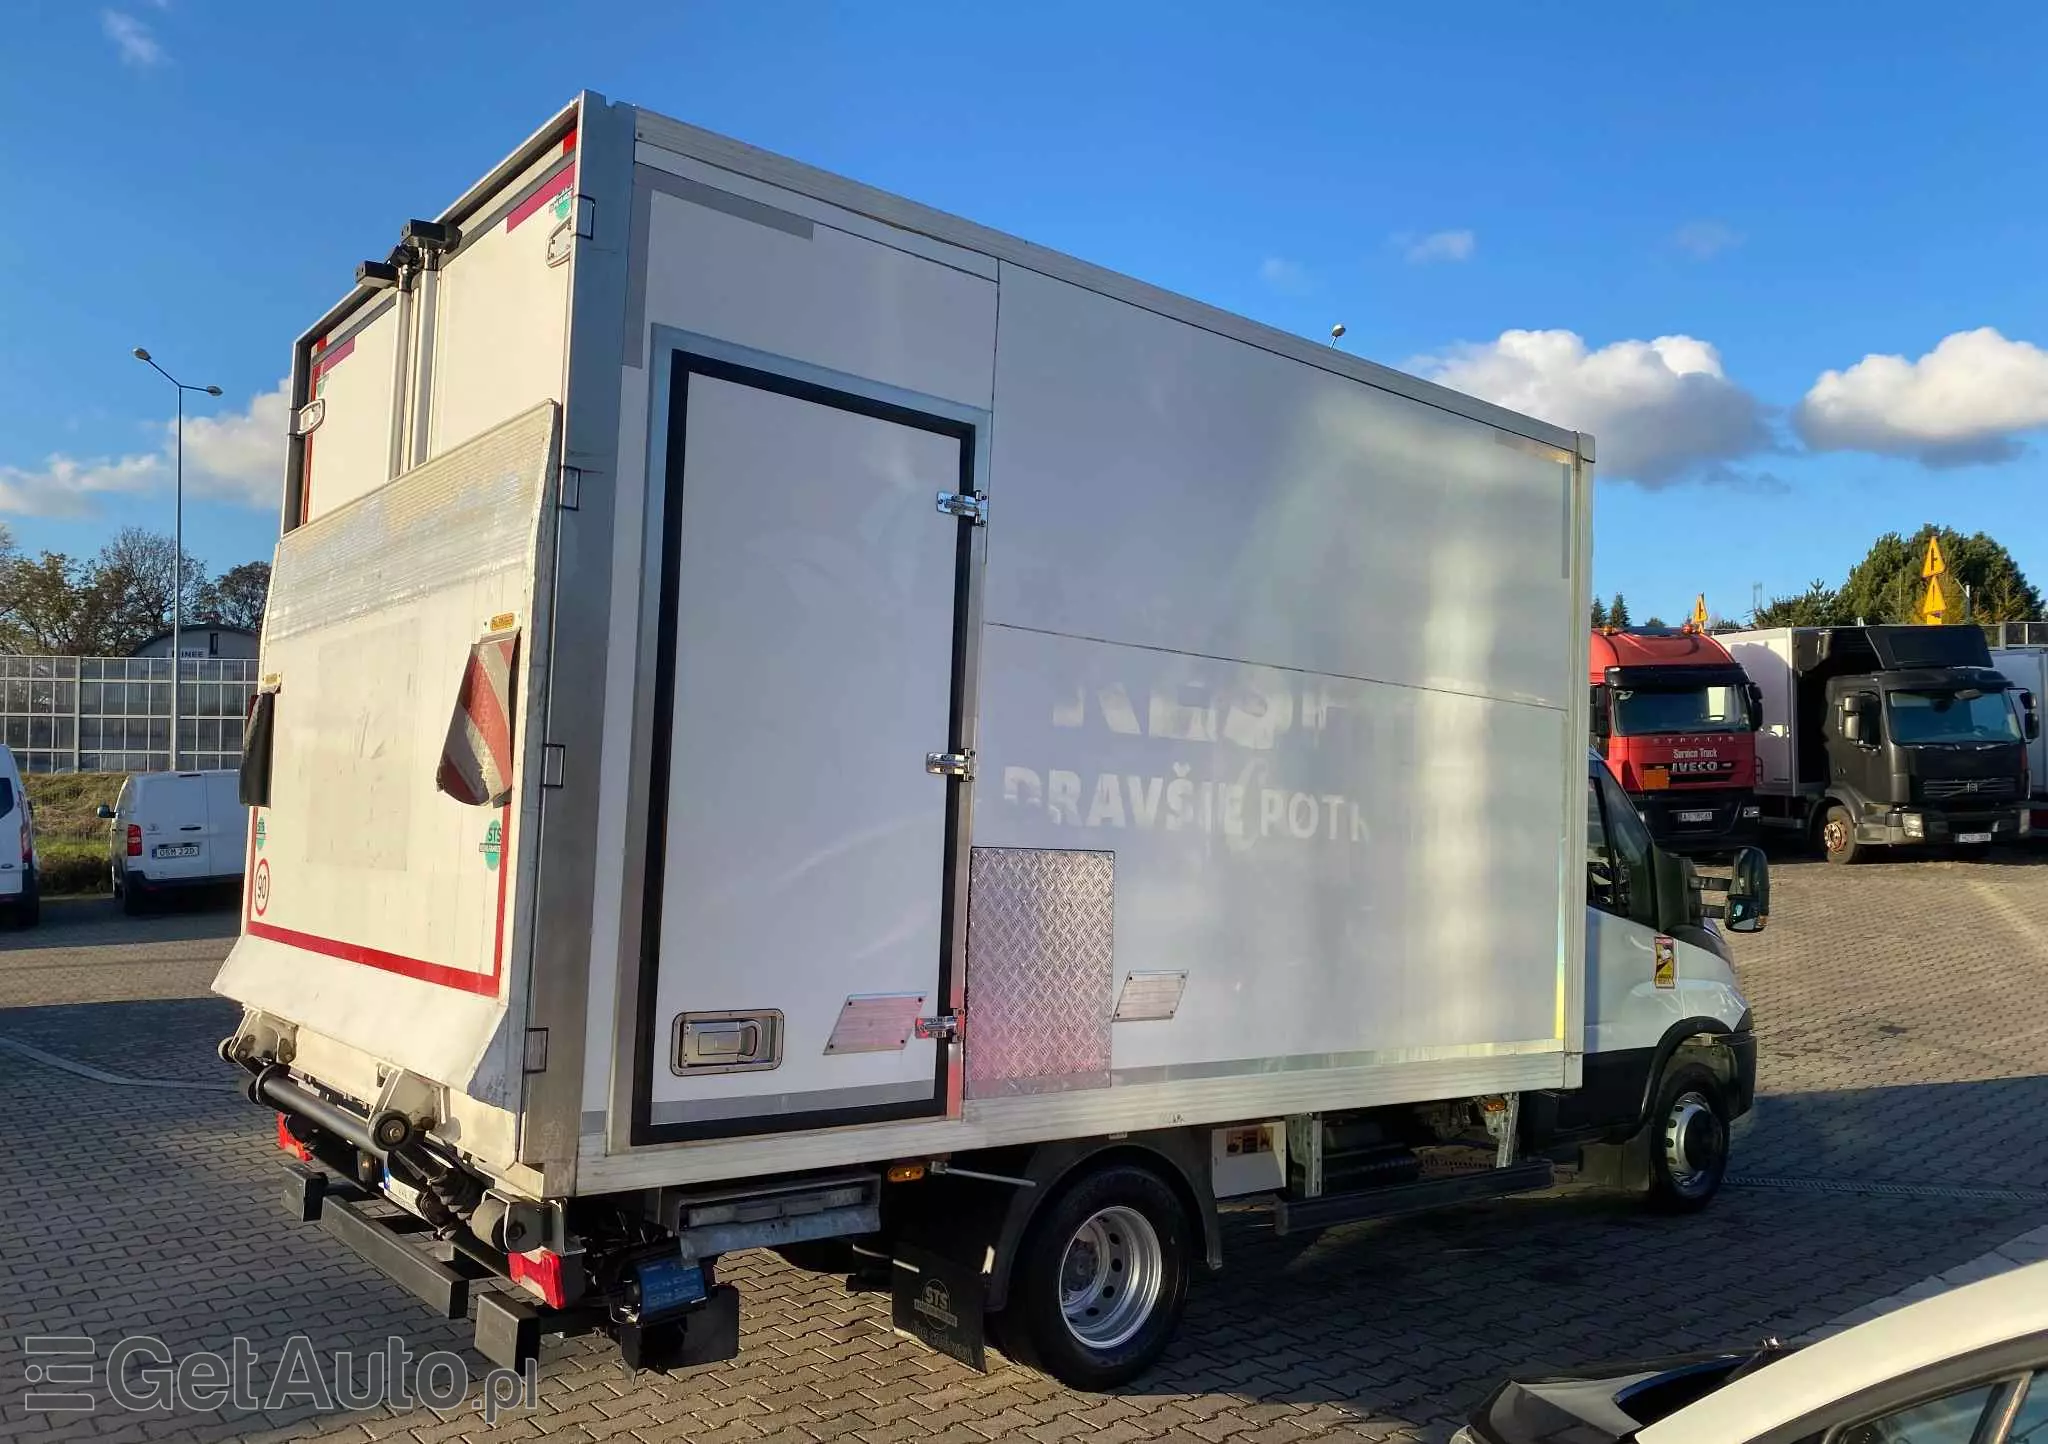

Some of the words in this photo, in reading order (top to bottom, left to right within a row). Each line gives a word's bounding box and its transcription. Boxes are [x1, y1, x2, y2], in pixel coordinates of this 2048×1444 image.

[1700, 747, 1718, 758] Truck
[1672, 761, 1718, 773] IVECO
[488, 827, 501, 842] STS
[258, 875, 266, 899] 90
[925, 1286, 949, 1310] STS
